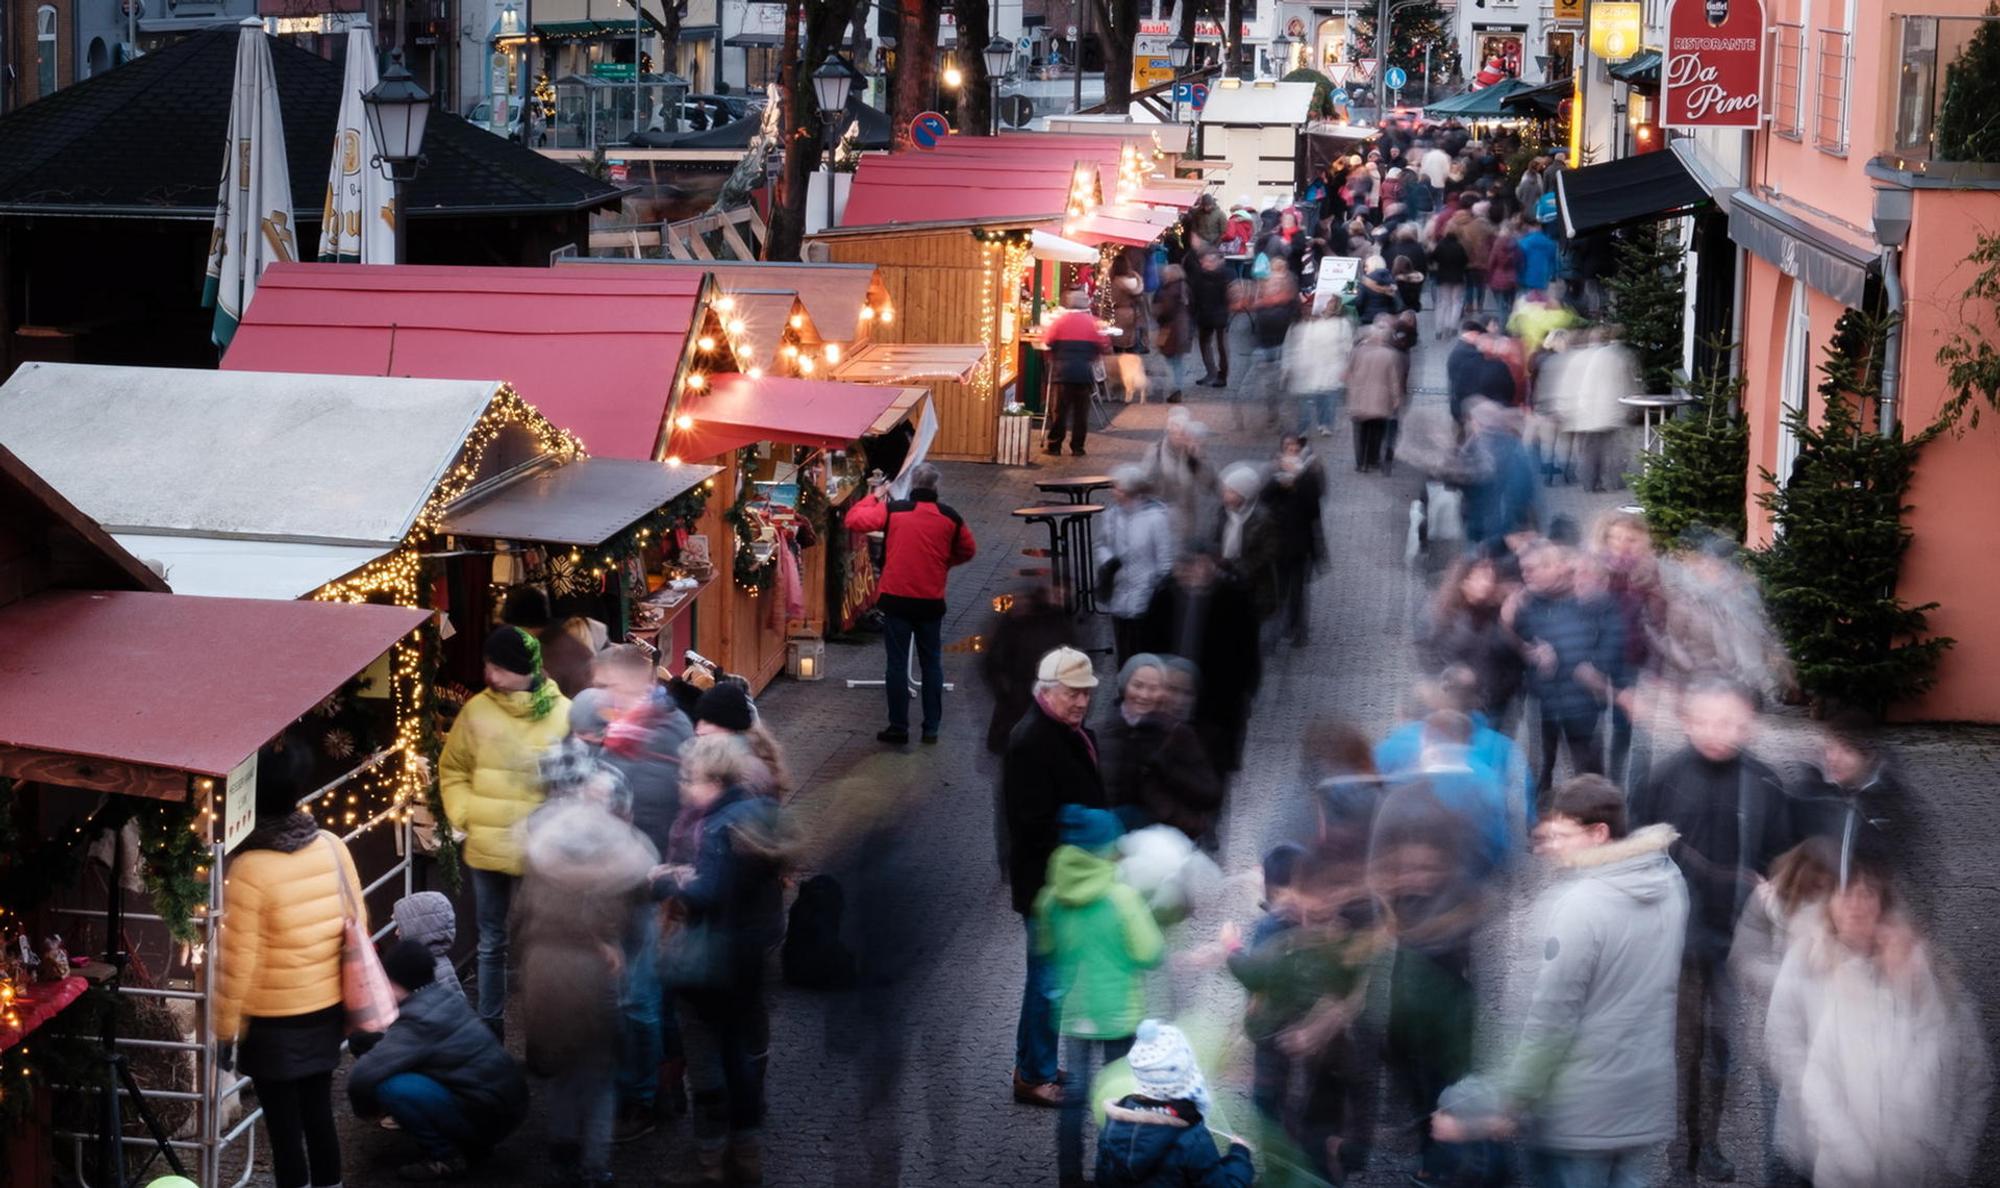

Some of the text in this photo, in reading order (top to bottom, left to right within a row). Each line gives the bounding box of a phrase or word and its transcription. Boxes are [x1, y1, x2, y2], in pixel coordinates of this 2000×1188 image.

[1674, 37, 1756, 51] RISTORANTE
[1667, 51, 1719, 89] Da
[1686, 83, 1760, 119] Pino
